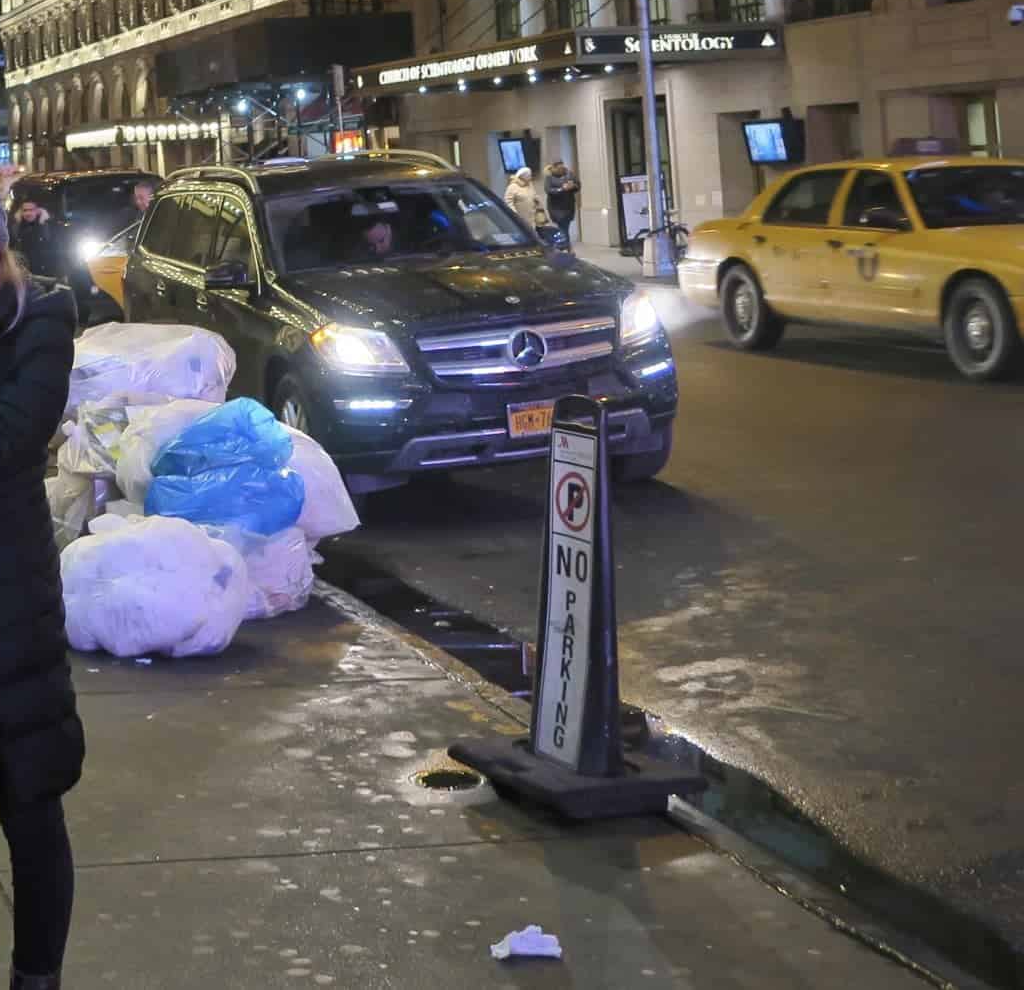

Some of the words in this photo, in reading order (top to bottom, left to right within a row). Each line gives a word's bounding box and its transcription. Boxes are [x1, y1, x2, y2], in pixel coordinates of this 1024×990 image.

[624, 33, 735, 53] SCENTOLOGY
[379, 68, 409, 85] CHURCH
[409, 66, 422, 80] OF
[421, 55, 475, 79] SCIENTOLOGY
[510, 44, 538, 66] YORK
[556, 543, 588, 583] NO
[553, 590, 577, 750] PARKING
